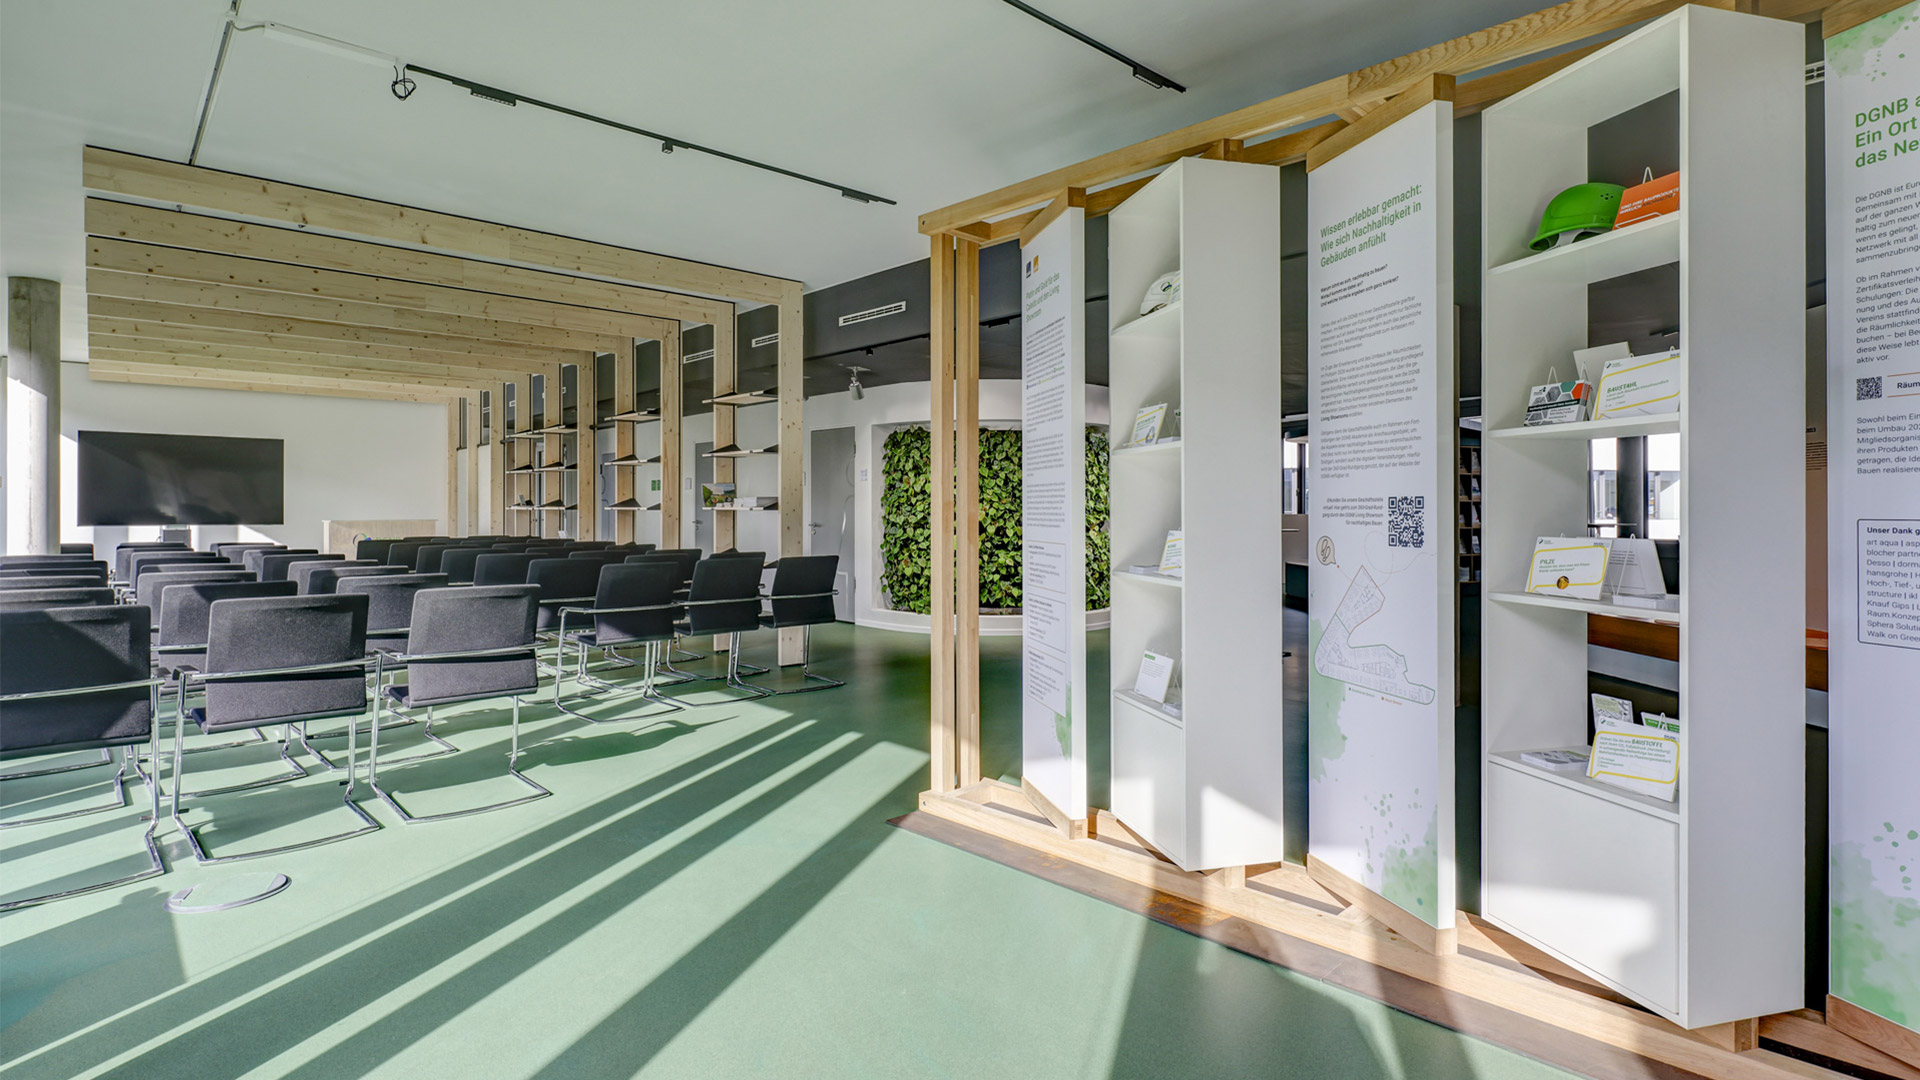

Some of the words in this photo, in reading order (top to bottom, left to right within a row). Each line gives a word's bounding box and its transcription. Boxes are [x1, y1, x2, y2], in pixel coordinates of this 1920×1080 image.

[1856, 98, 1908, 128] DGNB
[1856, 130, 1881, 148] Ein
[1888, 116, 1917, 136] Ort
[1855, 151, 1887, 168] das
[1894, 140, 1920, 156] Ne
[1869, 188, 1892, 198] DGNB
[1856, 196, 1902, 213] Gemeinsam
[1904, 192, 1917, 200] mit
[1320, 220, 1346, 238] Wissen
[1347, 204, 1380, 226] erlebbar
[1382, 184, 1422, 213] gemacht:
[1856, 215, 1868, 223] auf
[1870, 212, 1882, 220] der
[1884, 204, 1913, 218] ganzen
[1320, 240, 1334, 252] Wie
[1335, 232, 1350, 247] sich
[1352, 204, 1410, 239] Nachhaltigkeit
[1413, 201, 1421, 213] in
[1856, 224, 1876, 233] haltig
[1878, 219, 1895, 228] zum
[1856, 235, 1876, 243] wenn
[1320, 246, 1356, 267] Gebäuden
[1358, 232, 1386, 252] anfühlt
[1856, 240, 1892, 253] Netzwerk
[1894, 237, 1907, 245] mit
[1880, 266, 1913, 279] Rahmen
[1856, 290, 1903, 304] Schulungen:
[1905, 287, 1918, 295] Die
[1856, 305, 1875, 314] nung
[1877, 302, 1892, 310] und
[1856, 314, 1884, 324] Vereins
[1886, 308, 1920, 318] stattfind
[1856, 334, 1884, 344] buchen
[1856, 346, 1876, 354] diese
[1879, 342, 1902, 350] Weise
[1856, 356, 1874, 364] aktiv
[1607, 381, 1637, 393] BAUSTAHL
[1897, 381, 1920, 389] Räum
[1857, 416, 1885, 424] Sowohl
[1878, 425, 1906, 433] Umbau
[1878, 445, 1918, 453] Produkten
[1892, 527, 1912, 535] Dank
[1880, 540, 1899, 548] aqua
[1867, 559, 1891, 567] Desso
[1867, 569, 1908, 579] hansgrohe
[1867, 590, 1902, 599] structure
[1867, 600, 1890, 608] Knauf
[1892, 602, 1910, 610] Gips
[1867, 620, 1894, 629] Sphera
[1867, 630, 1886, 638] Walk
[1632, 739, 1663, 748] BAUSTOFFE
